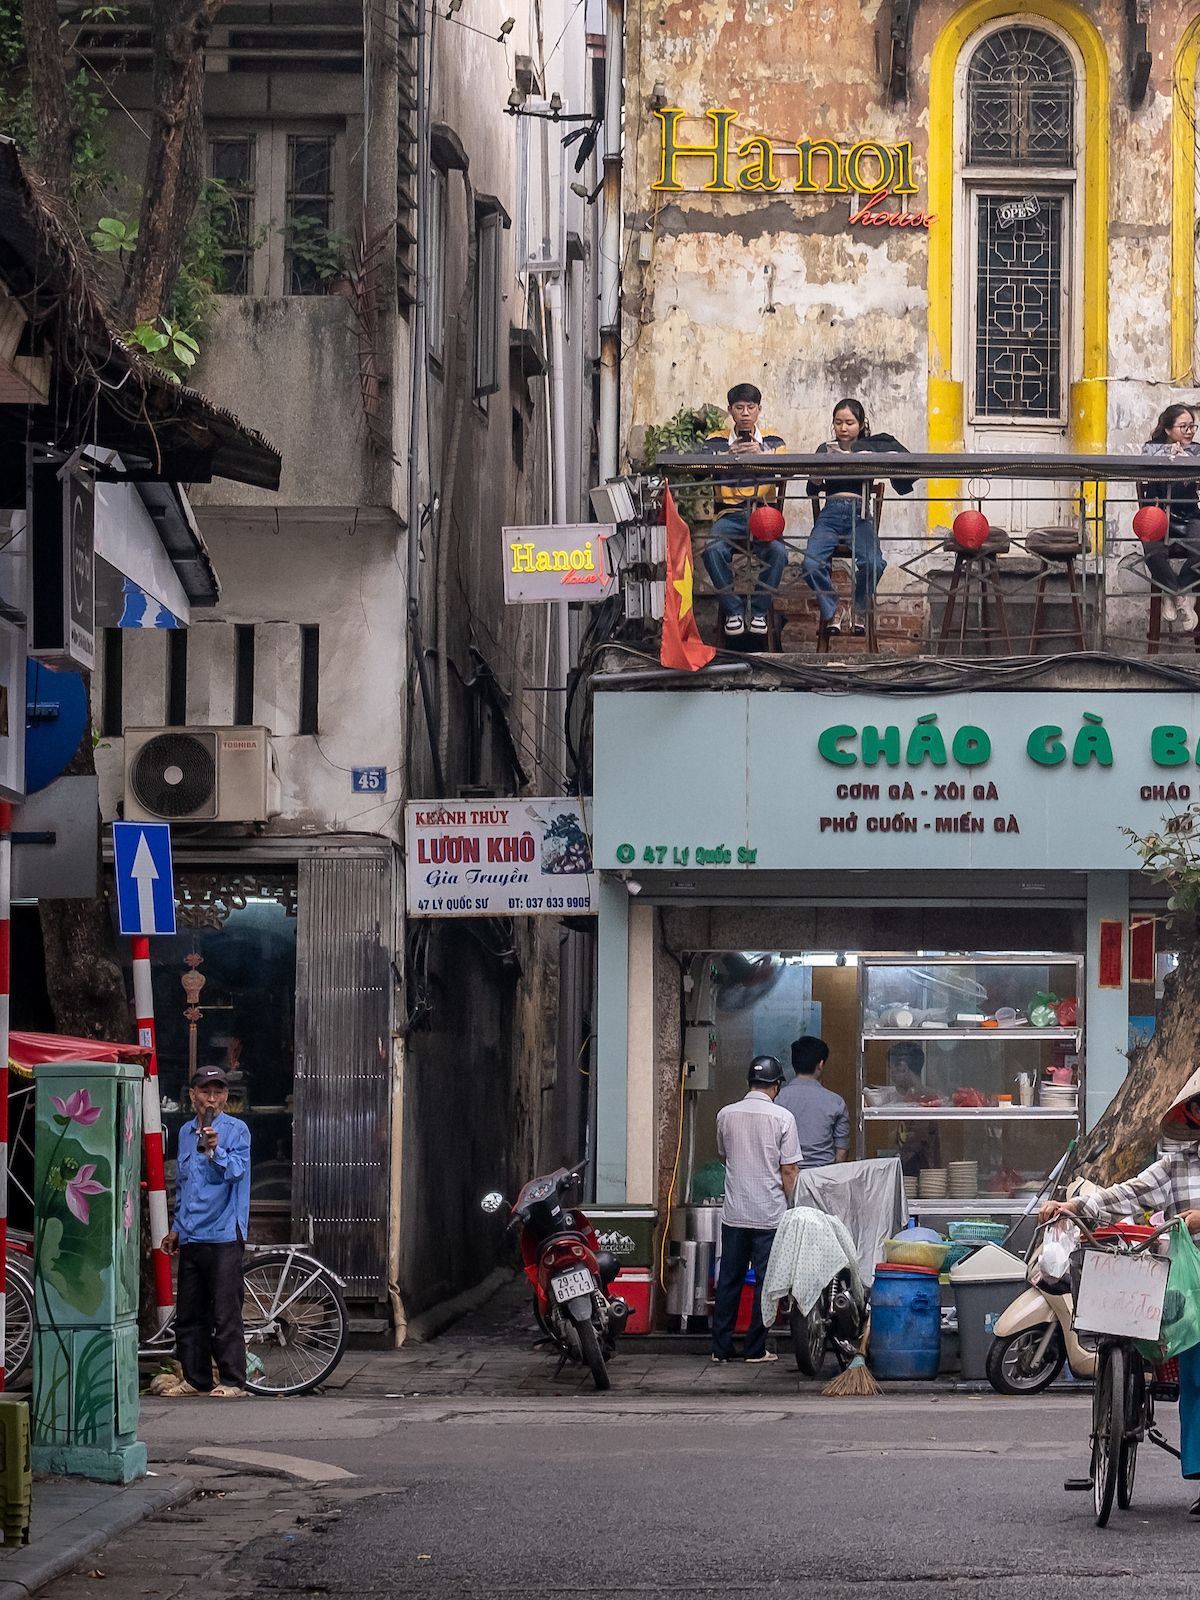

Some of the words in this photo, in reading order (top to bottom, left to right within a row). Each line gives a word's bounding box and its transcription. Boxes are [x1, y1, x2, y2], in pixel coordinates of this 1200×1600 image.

[652, 108, 919, 194] Hanoi
[849, 189, 939, 227] house
[1001, 201, 1037, 220] OPEN
[510, 542, 594, 572] Hanoi
[223, 741, 257, 749] TOSHIBA
[818, 713, 991, 766] CHÁO
[1026, 711, 1113, 767] GÀ
[358, 771, 380, 789] 45
[836, 782, 880, 800] CƠM
[888, 781, 915, 800] GÀ
[934, 781, 966, 800] XÔI
[972, 781, 999, 800] GÀ
[1140, 781, 1190, 800] CHÁO
[470, 805, 509, 824] THỦY
[820, 811, 858, 832] PHỞ
[866, 811, 918, 832] CUỐN
[935, 811, 985, 833] MIẾN
[993, 814, 1020, 833] GÀ
[418, 835, 480, 864] LƯƠN
[487, 831, 535, 863] KHÔ
[643, 845, 667, 864] 47
[673, 847, 689, 866] Lý
[695, 843, 732, 865] Quốc
[425, 869, 459, 888] Gia
[464, 868, 529, 887] Truyền
[418, 899, 430, 910] 47
[432, 896, 443, 910] LÝ
[446, 895, 472, 911] QUỐC
[475, 897, 490, 909] SƯ
[526, 897, 543, 908] 037
[546, 897, 564, 908] 633
[557, 1272, 585, 1289] 29-C1
[557, 1281, 591, 1300] 815.43
